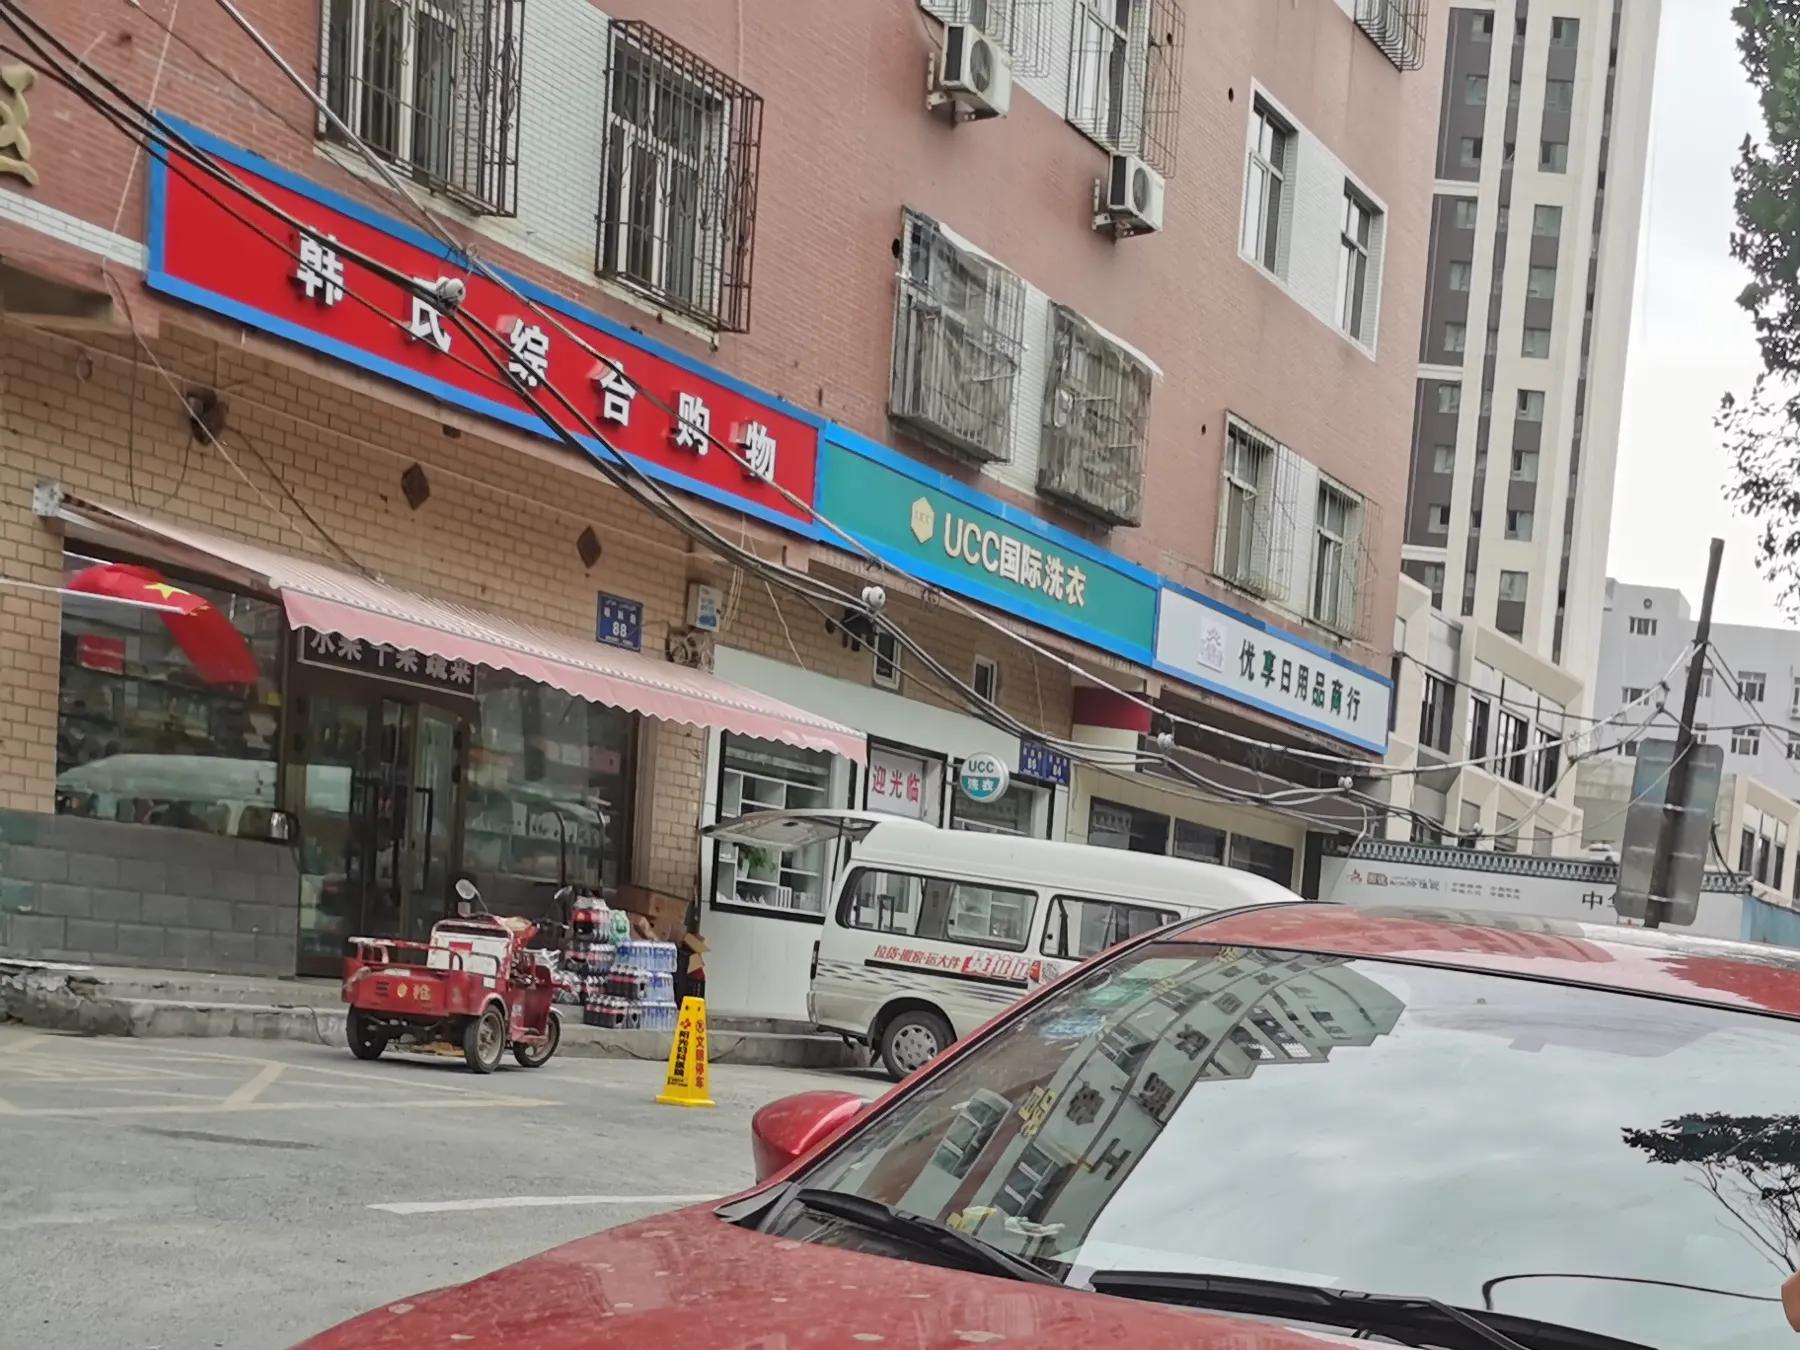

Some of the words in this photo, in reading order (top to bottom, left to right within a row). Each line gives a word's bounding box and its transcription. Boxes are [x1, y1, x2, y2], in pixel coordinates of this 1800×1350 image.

[298, 227, 776, 481] 韩氏综合购物
[943, 512, 1087, 608] UCC国际洗衣
[612, 620, 628, 638] 88
[1239, 639, 1361, 722] 优享日用品商行
[968, 759, 994, 774] UCC
